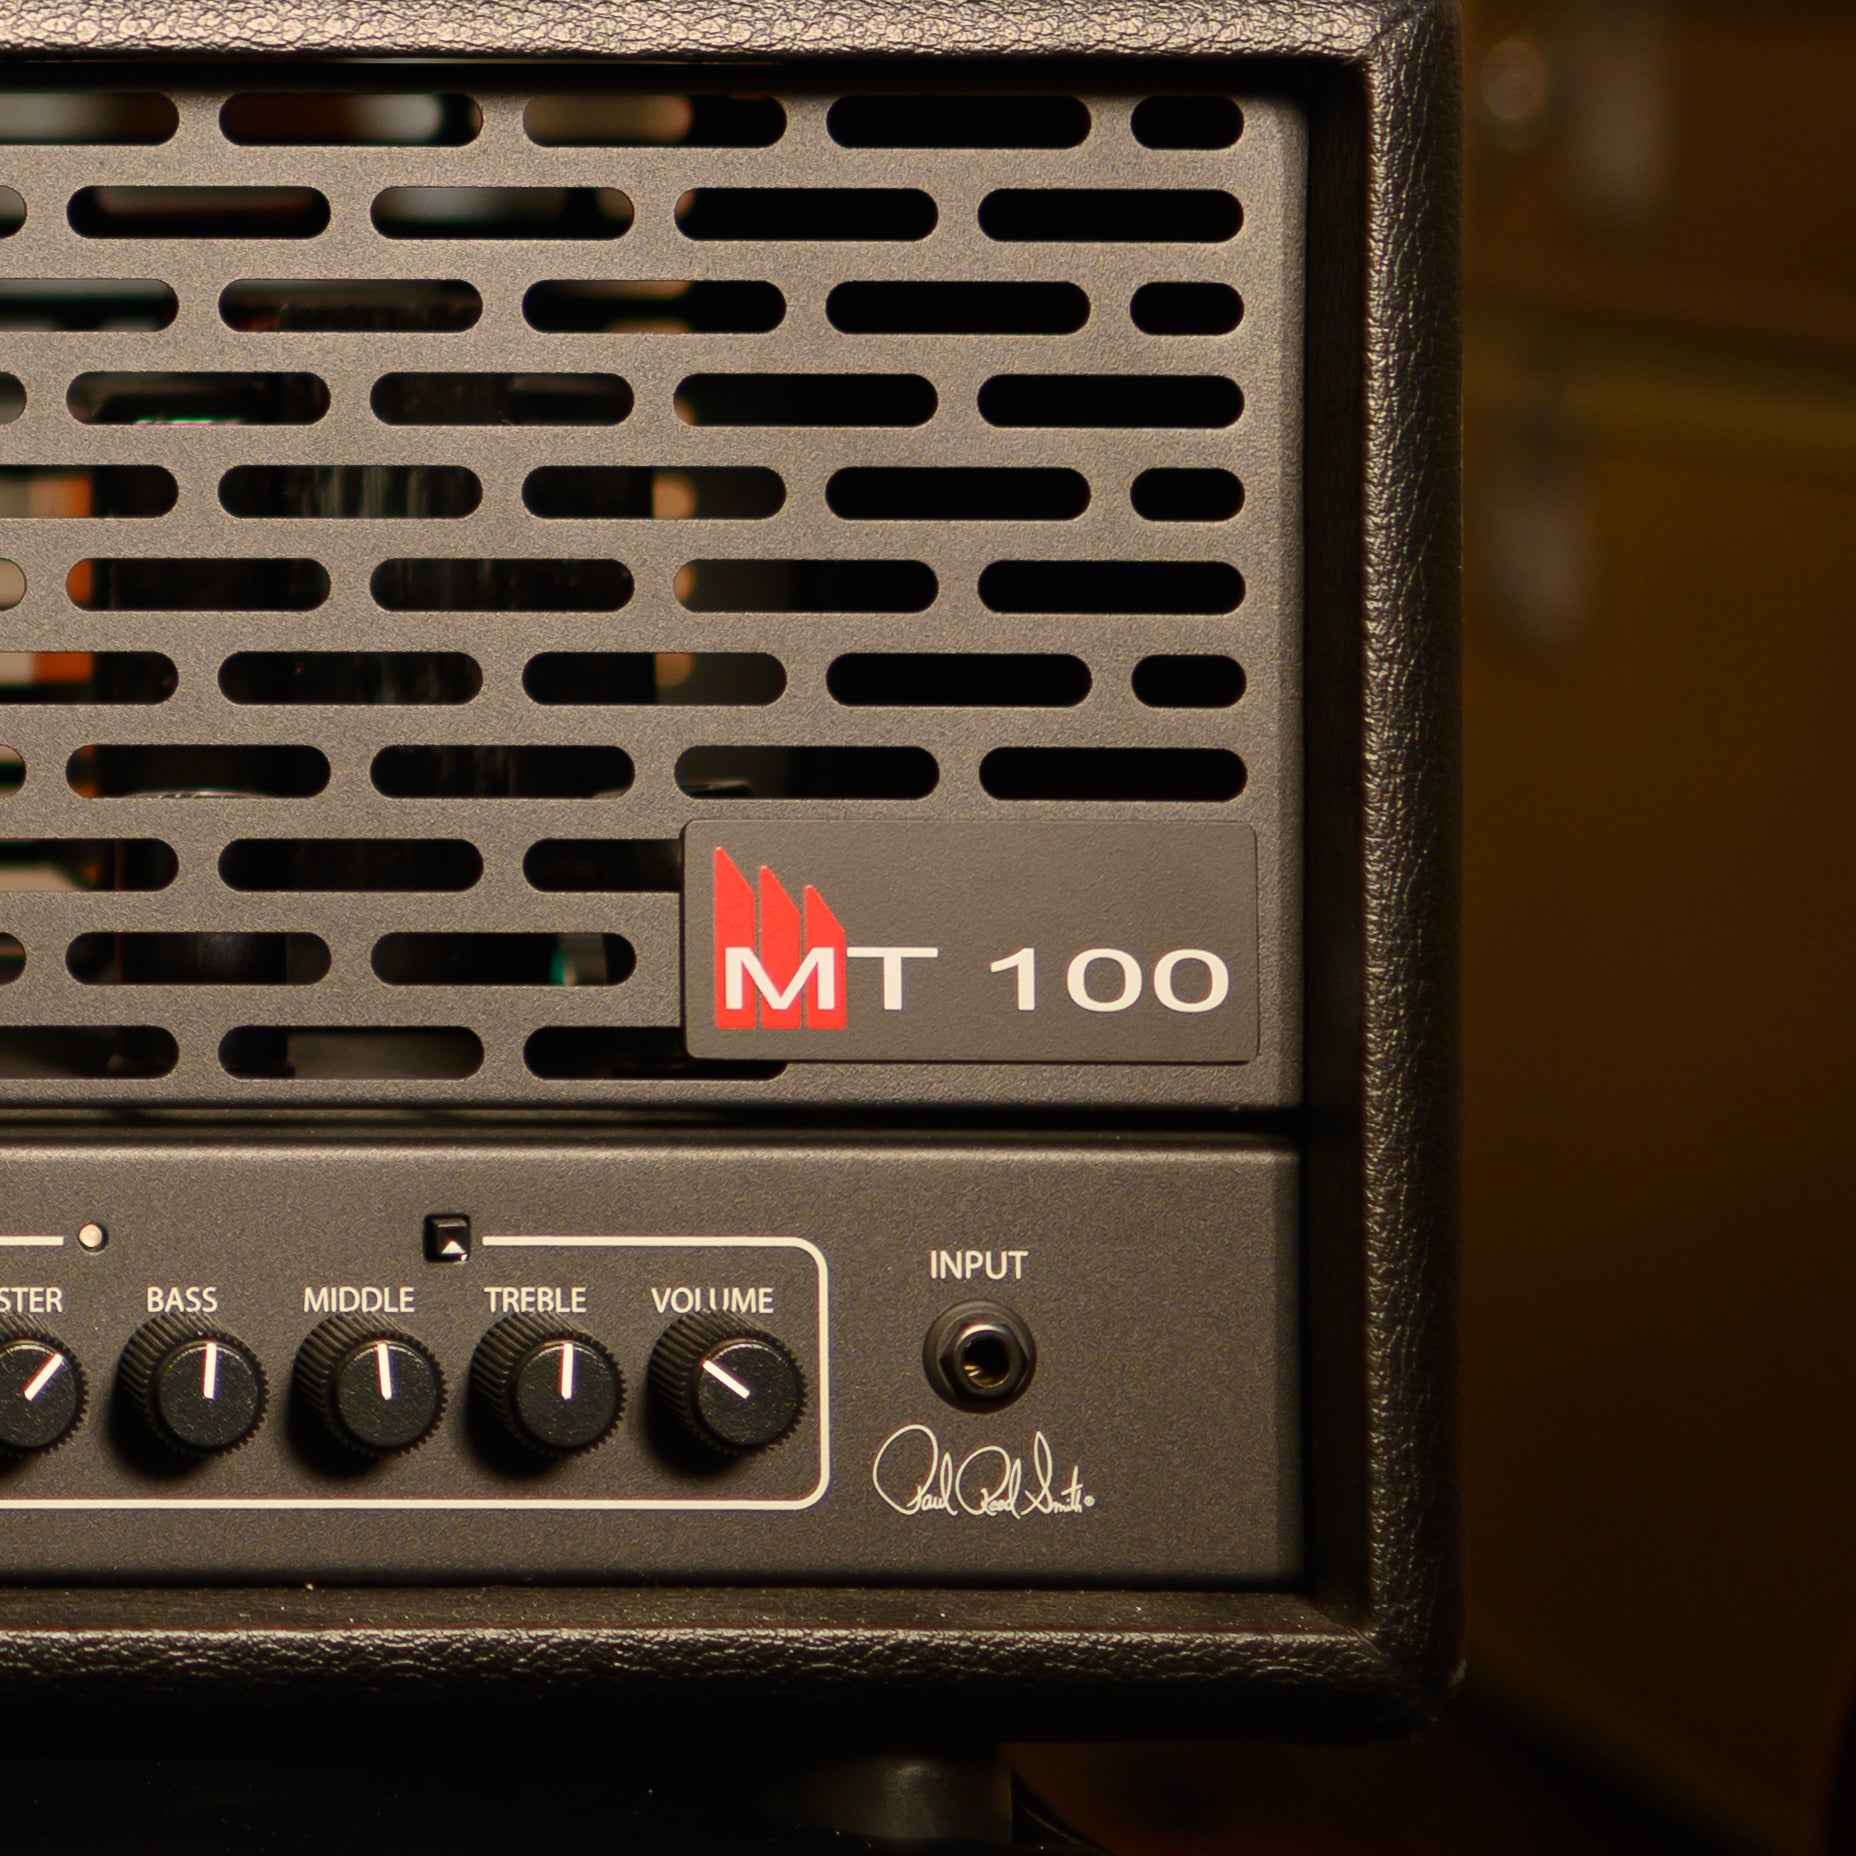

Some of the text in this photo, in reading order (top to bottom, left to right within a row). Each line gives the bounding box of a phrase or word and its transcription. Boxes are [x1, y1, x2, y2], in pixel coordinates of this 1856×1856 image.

[723, 946, 1230, 1013] MT 100
[929, 1248, 1030, 1281] INPUT
[146, 1285, 219, 1316] BASS
[302, 1284, 417, 1314] MIDDLE
[482, 1285, 588, 1315] TREBLE
[649, 1285, 775, 1316] VOLUME
[872, 1423, 959, 1516] Paul
[954, 1445, 1022, 1520] Reed
